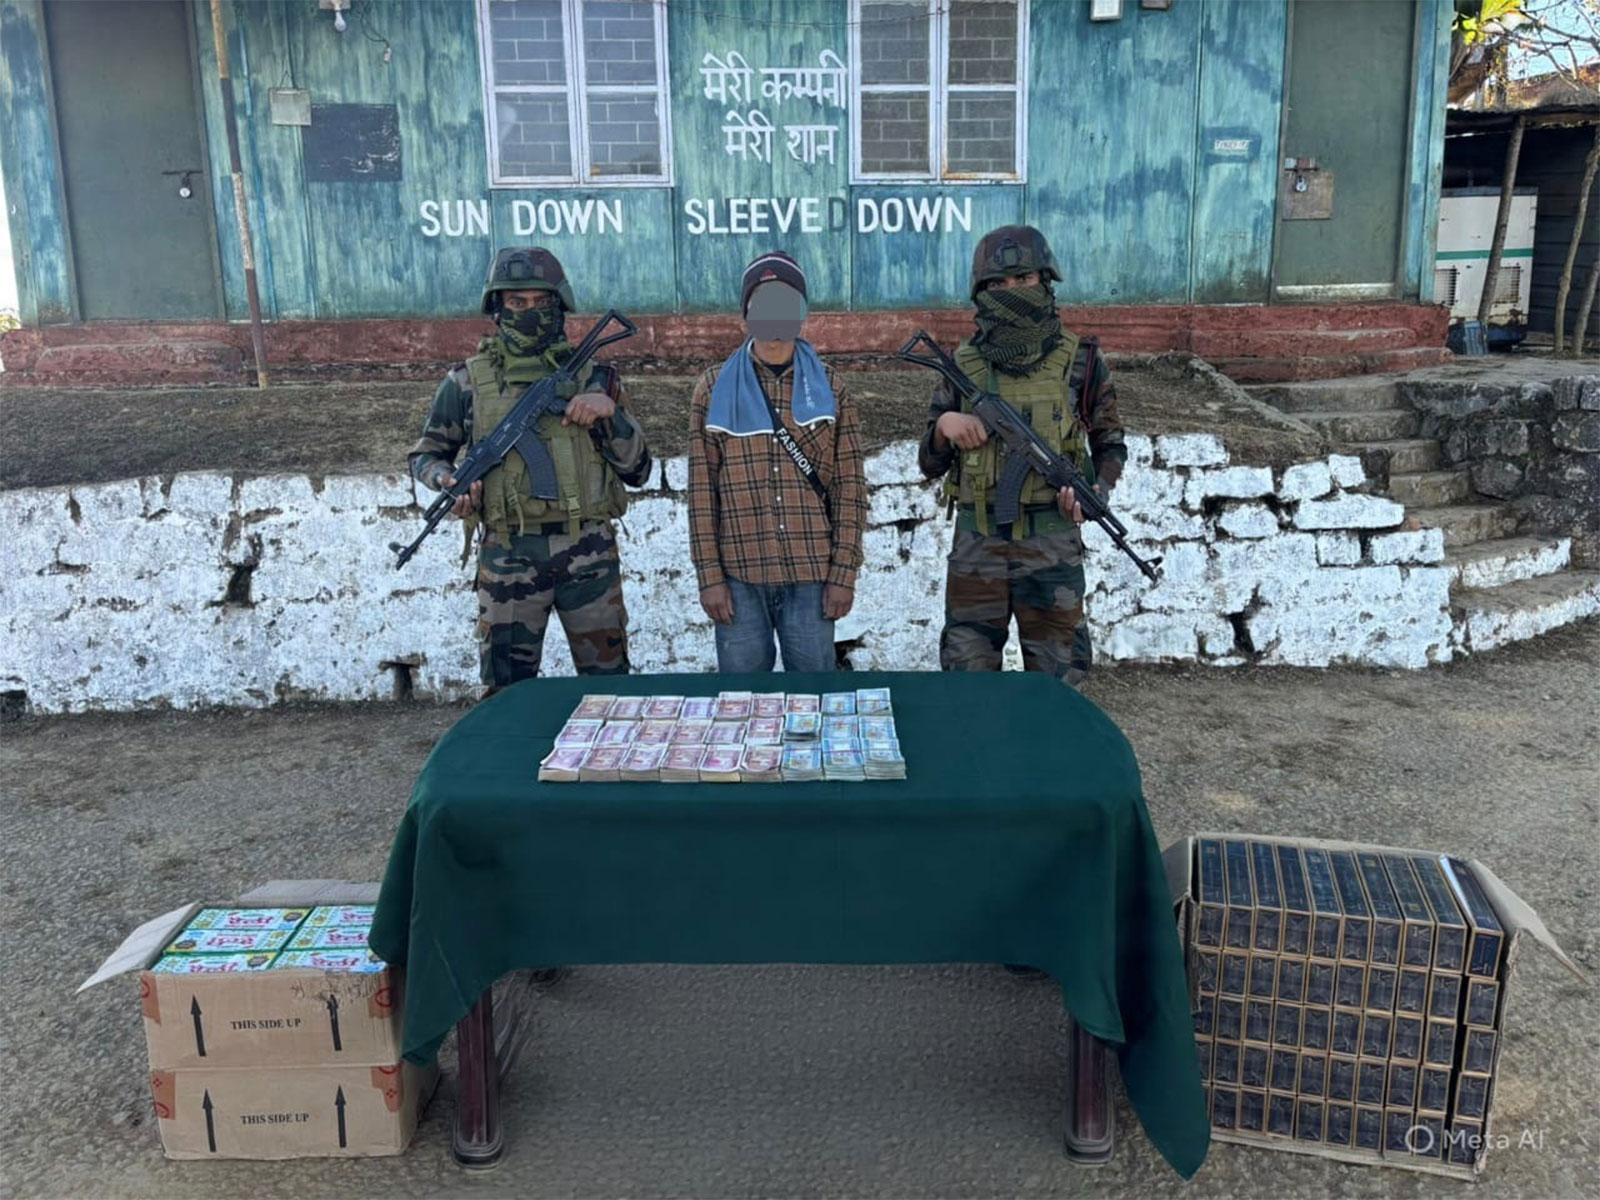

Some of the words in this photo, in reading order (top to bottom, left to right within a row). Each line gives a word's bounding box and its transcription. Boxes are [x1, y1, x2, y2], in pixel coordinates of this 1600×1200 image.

[699, 50, 755, 106] मेरी
[759, 49, 848, 110] कम्पनी
[721, 109, 776, 164] मेरी
[783, 124, 839, 165] शान
[419, 199, 490, 237] SUN
[511, 199, 624, 236] DOWN
[857, 197, 973, 234] DOWN
[776, 427, 814, 476] FASHION
[230, 1020, 257, 1031] THIS
[258, 1019, 284, 1030] SIDE
[286, 1017, 302, 1028] UP
[240, 1114, 266, 1125] THIS
[267, 1113, 293, 1124] SIDE
[295, 1112, 310, 1123] UP
